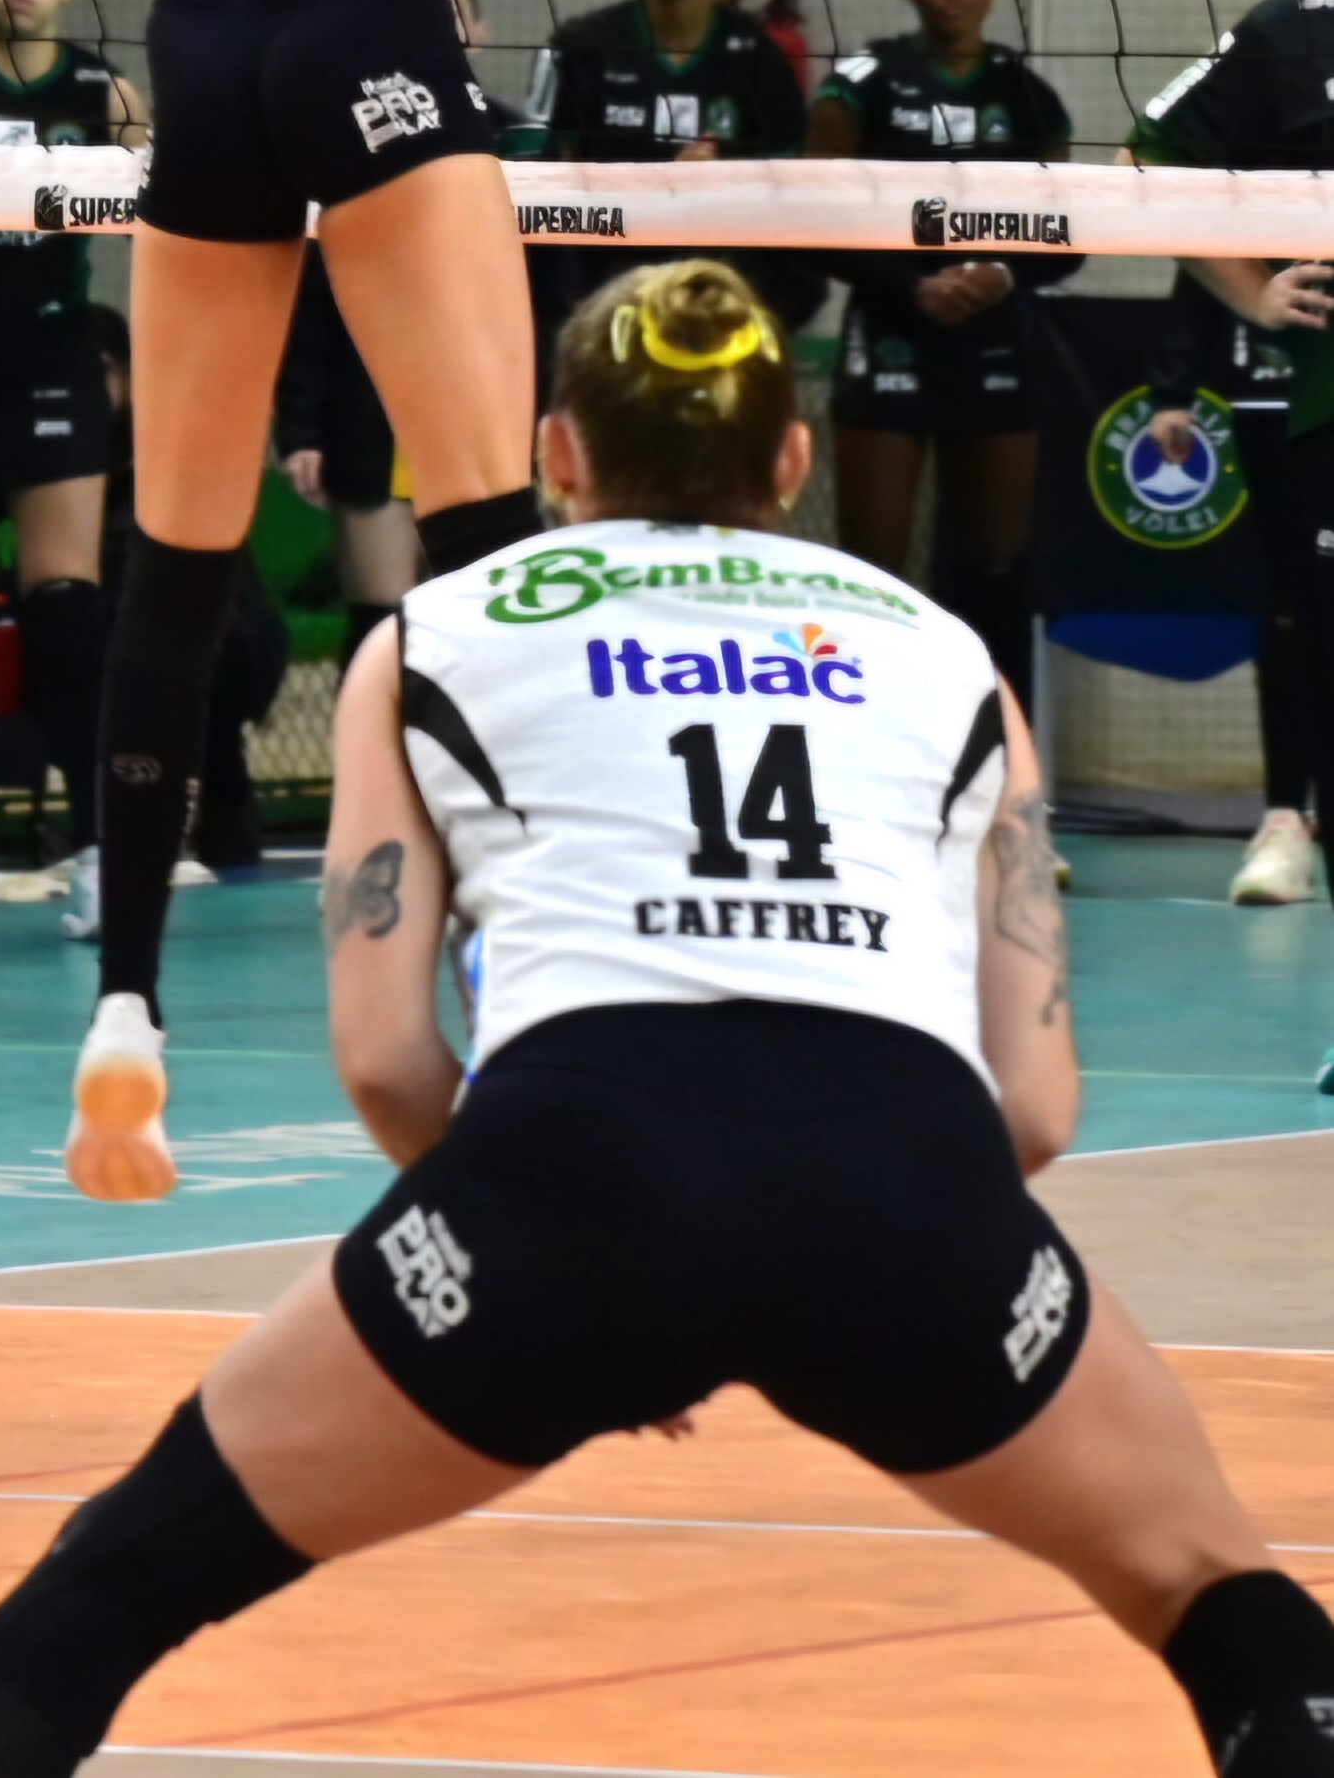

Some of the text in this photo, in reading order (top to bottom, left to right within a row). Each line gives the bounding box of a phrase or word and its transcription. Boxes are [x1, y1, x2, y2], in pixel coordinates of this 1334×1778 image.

[69, 197, 137, 227] SUPER
[516, 205, 626, 238] UPERLIGA
[949, 212, 1071, 246] SUPERLIGA
[586, 639, 866, 704] Italac
[668, 722, 838, 880] 14
[635, 897, 890, 952] CAFFREY
